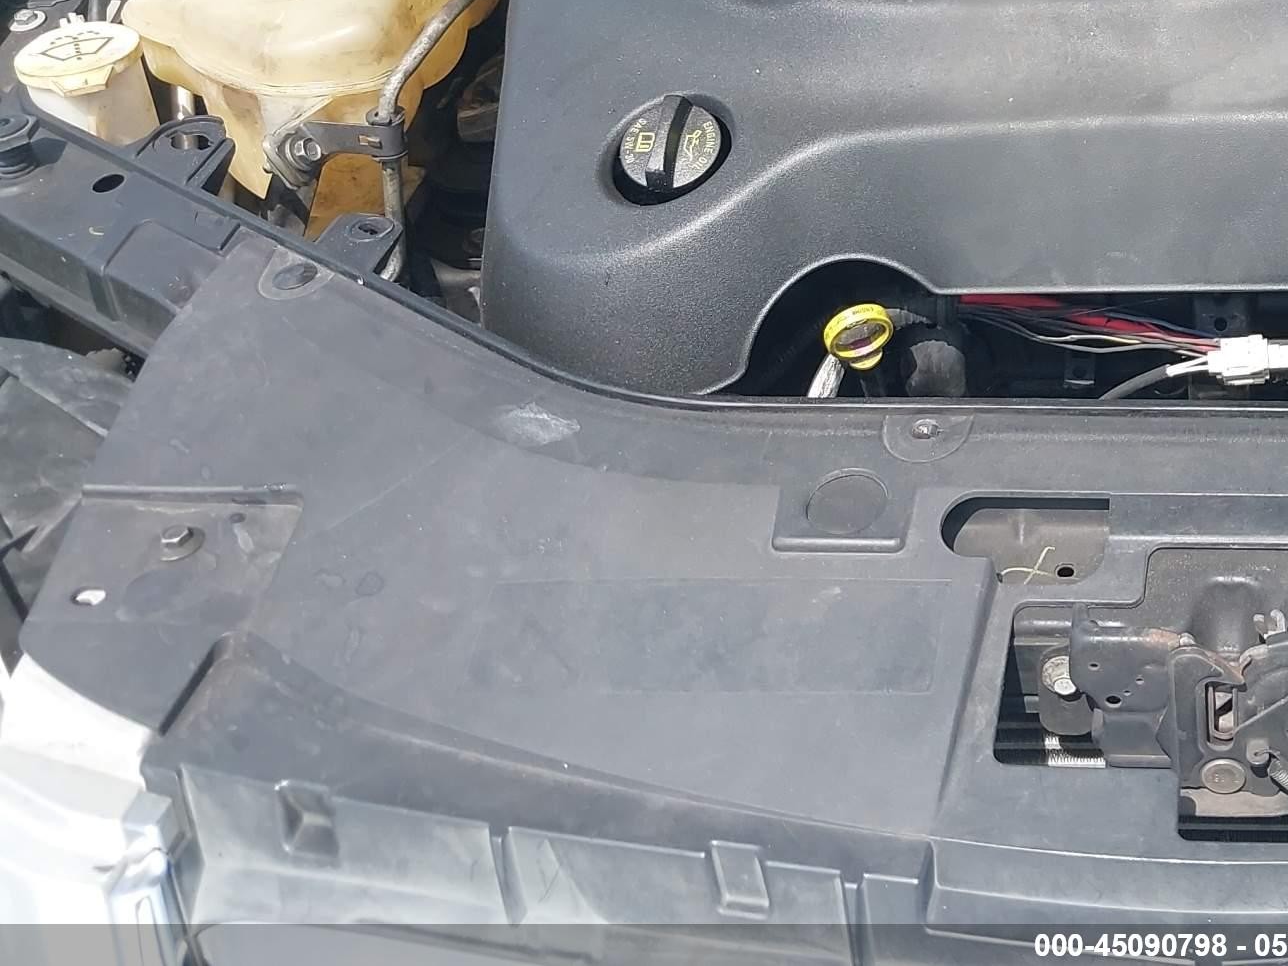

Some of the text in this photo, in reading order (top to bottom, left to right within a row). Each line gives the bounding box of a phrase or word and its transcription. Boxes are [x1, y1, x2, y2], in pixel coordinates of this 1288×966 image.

[624, 118, 647, 164] SAE 5W-30
[688, 121, 716, 170] ENGINE OIL
